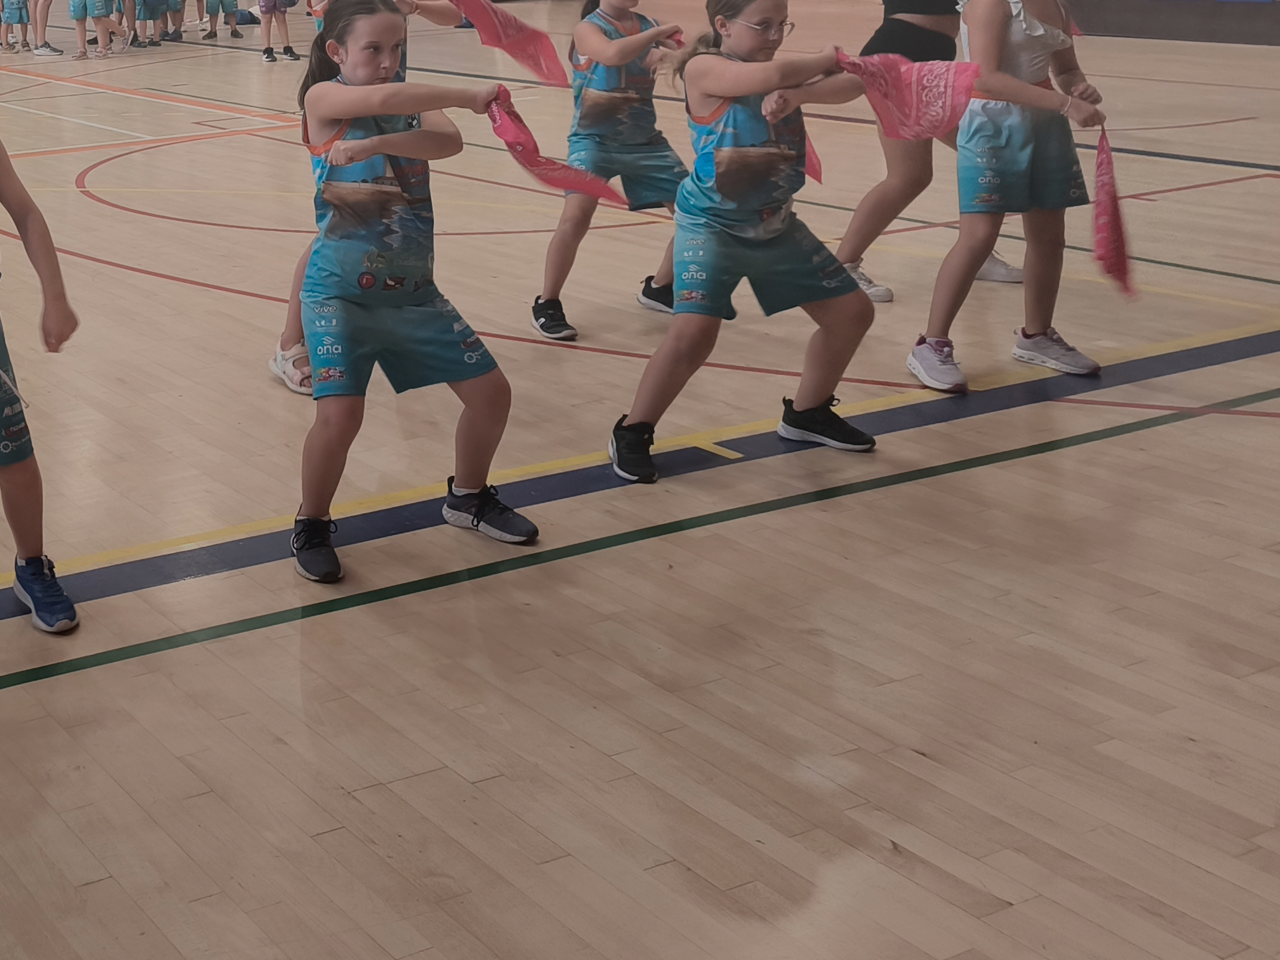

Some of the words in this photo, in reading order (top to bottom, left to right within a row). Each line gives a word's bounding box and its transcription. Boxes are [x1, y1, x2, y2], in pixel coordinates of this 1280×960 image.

[681, 271, 707, 280] ona
[313, 305, 337, 314] vive
[316, 344, 342, 355] ona
